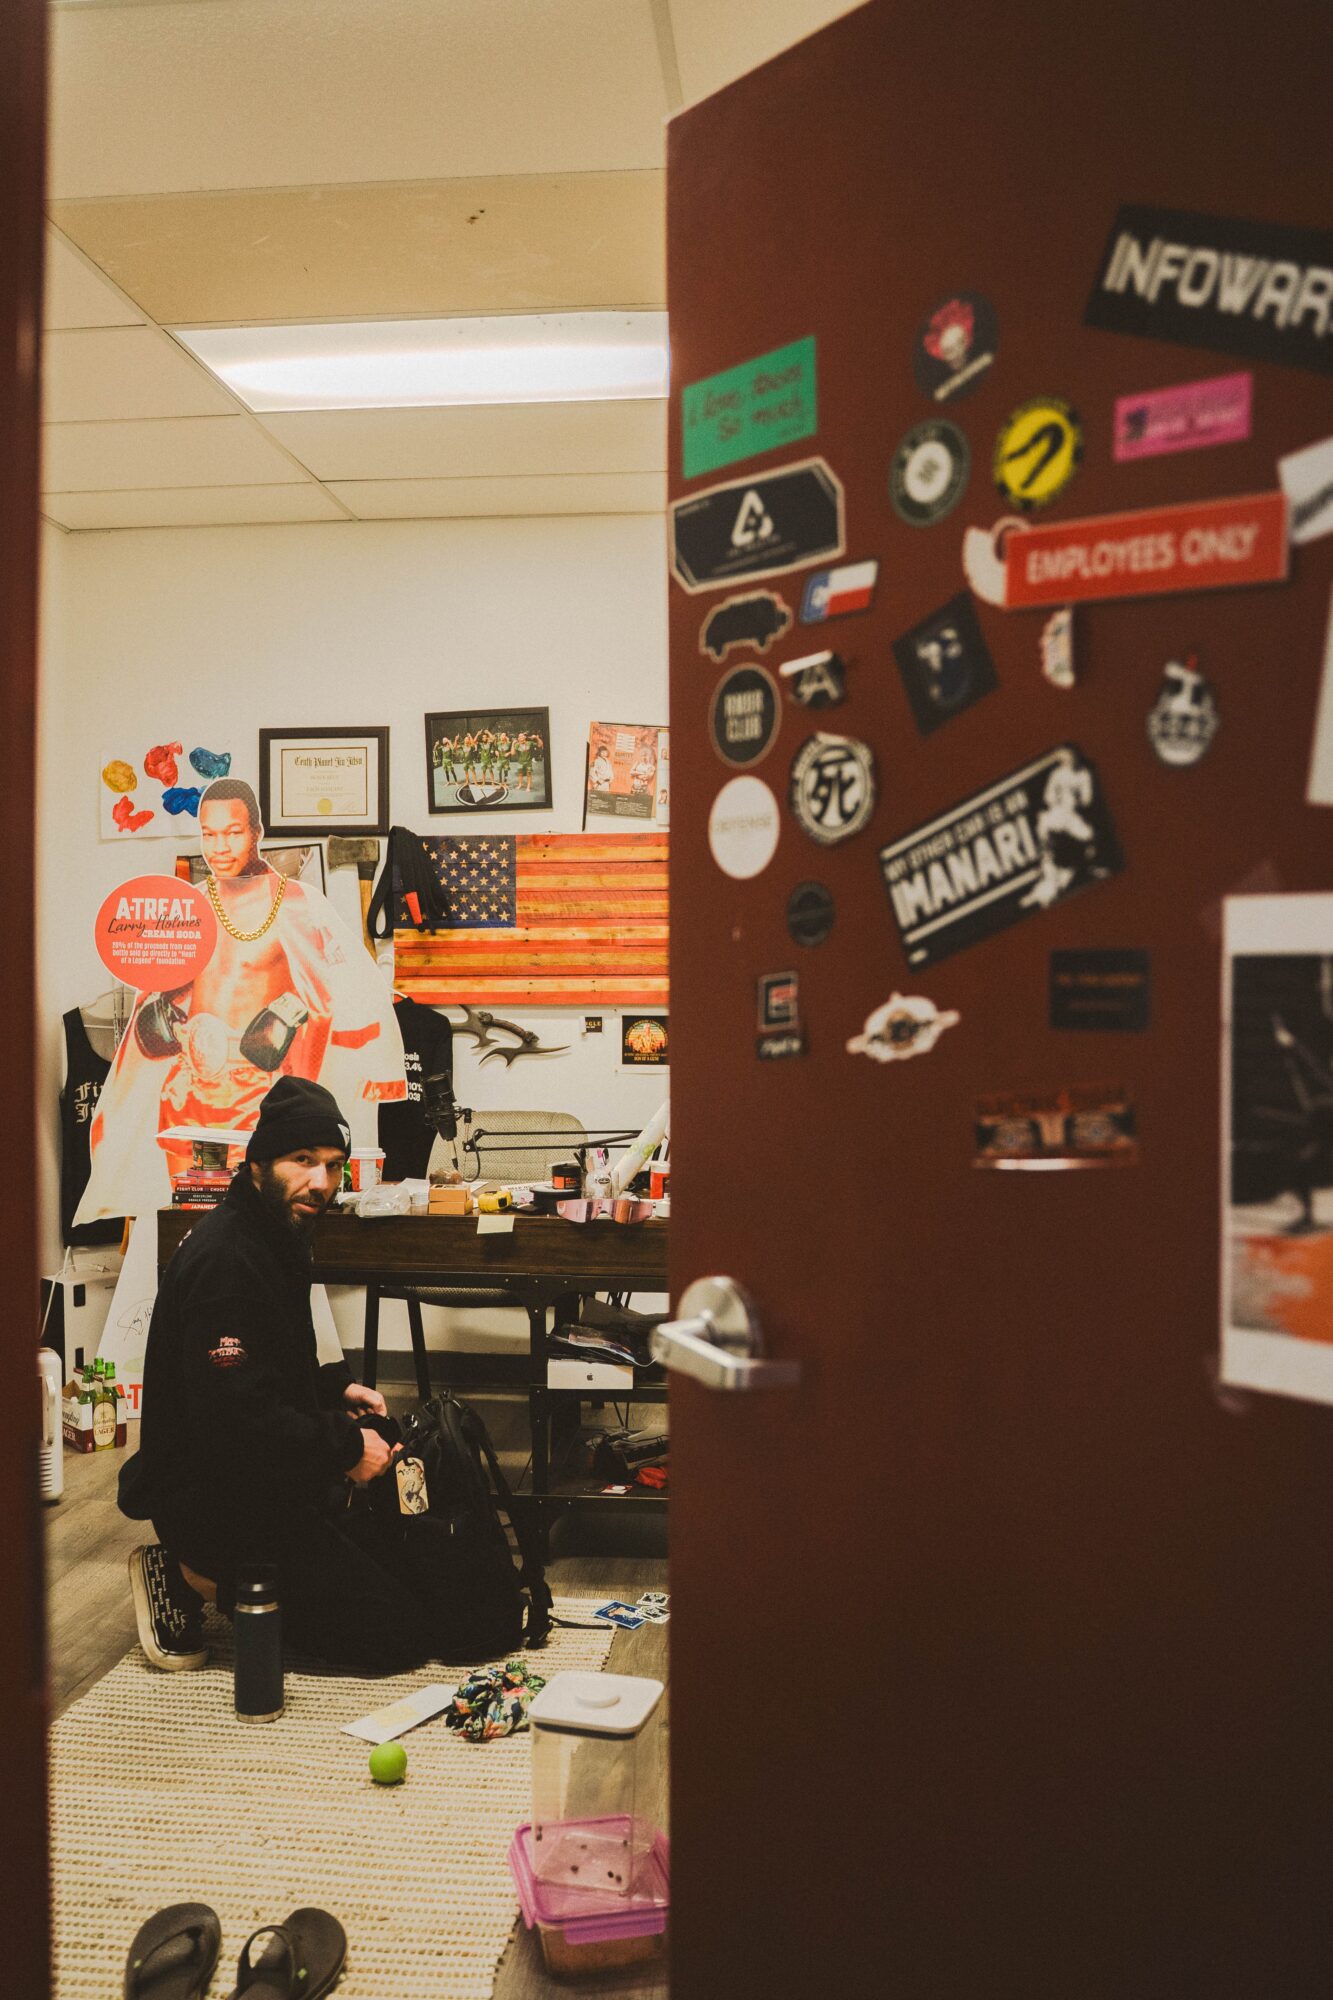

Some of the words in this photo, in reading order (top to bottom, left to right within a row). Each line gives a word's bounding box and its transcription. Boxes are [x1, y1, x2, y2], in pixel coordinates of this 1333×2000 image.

[1102, 232, 1333, 338] INFOWAR
[1025, 531, 1176, 585] EMPLOYEES
[1180, 523, 1259, 566] ONLY
[107, 917, 147, 938] Larry
[153, 913, 202, 930] Holmes
[142, 929, 175, 939] CREAM
[176, 930, 202, 940] SODA
[127, 941, 134, 950] of
[134, 941, 143, 950] the
[170, 942, 182, 950] from
[183, 943, 197, 951] each
[112, 949, 129, 957] bottle
[129, 949, 141, 957] sold
[150, 950, 171, 958] directly
[121, 957, 127, 965] of
[404, 1052, 420, 1061] osh
[74, 1082, 105, 1102] Fi
[63, 1428, 76, 1442] AGER
